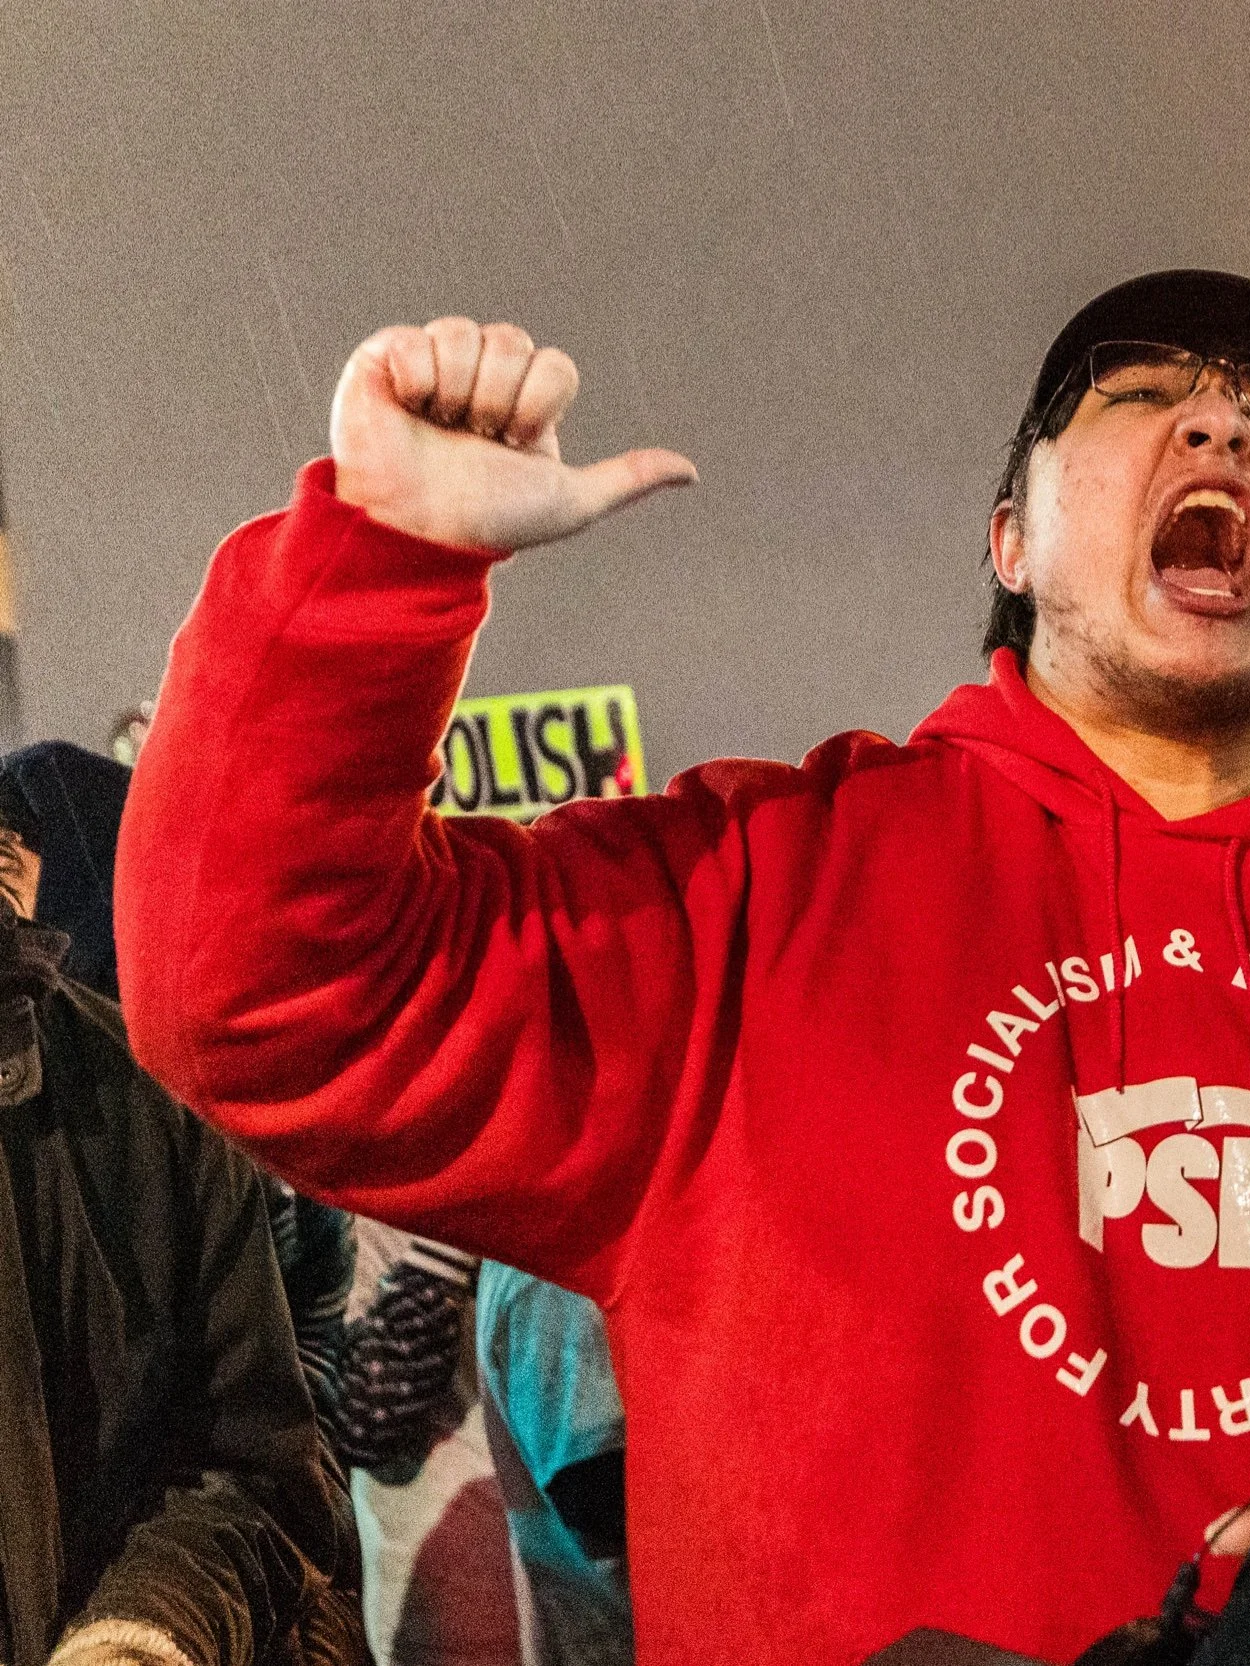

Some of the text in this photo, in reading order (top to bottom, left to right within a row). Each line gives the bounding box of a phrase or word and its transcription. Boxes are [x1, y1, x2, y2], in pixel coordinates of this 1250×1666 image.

[431, 699, 627, 811] OLISH
[982, 1253, 1107, 1397] FOR
[1163, 929, 1203, 972] &
